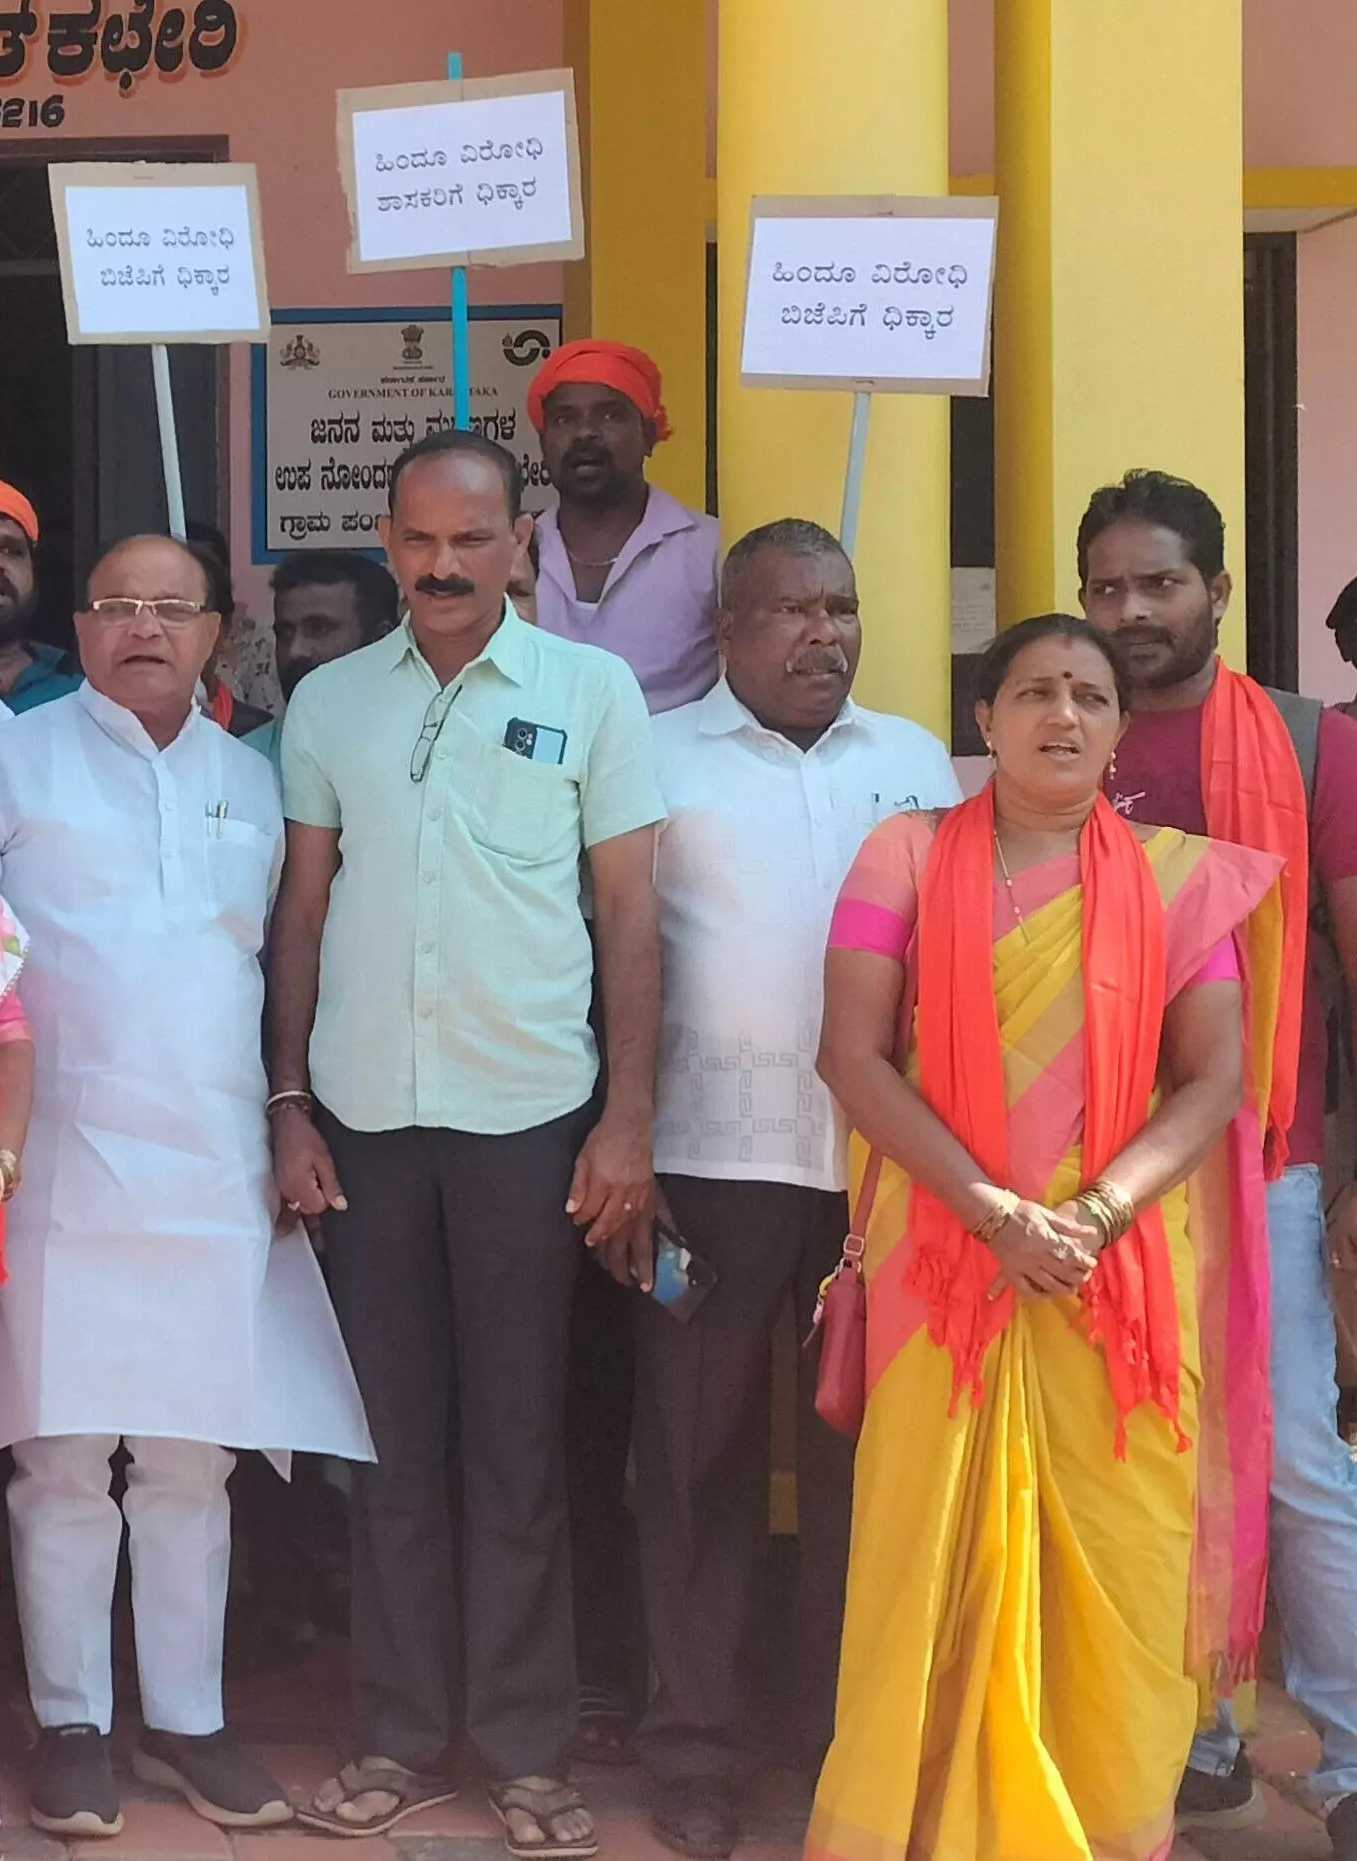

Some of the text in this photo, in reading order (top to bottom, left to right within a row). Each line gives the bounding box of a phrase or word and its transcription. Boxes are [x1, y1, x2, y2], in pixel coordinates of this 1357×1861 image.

[375, 135, 544, 172] ಹಿಂದೂ ವಿರೋಧಿ
[377, 175, 537, 212] ಶಾಸಕರಿಗೆ ಧಿಕ್ಕಾರ
[86, 225, 235, 250] ಹಿಂದೂ ವಿರೋಧಿ
[99, 263, 230, 296] ಬಿಜೆಪಿಗೆ ಧಿಕ್ಕಾರ
[772, 260, 968, 289] ಹಿಂದೂ ವಿರೋಧಿ
[781, 301, 955, 340] ಬಿಜೆಪಿಗೆ ಧಿಕ್ಕಾರ
[328, 386, 499, 400] GOVERNMENT OF KARTAKA
[310, 411, 361, 444] ಜನನ
[275, 459, 311, 491] ಉಪ
[279, 510, 331, 541] ಗ್ರಾಮ
